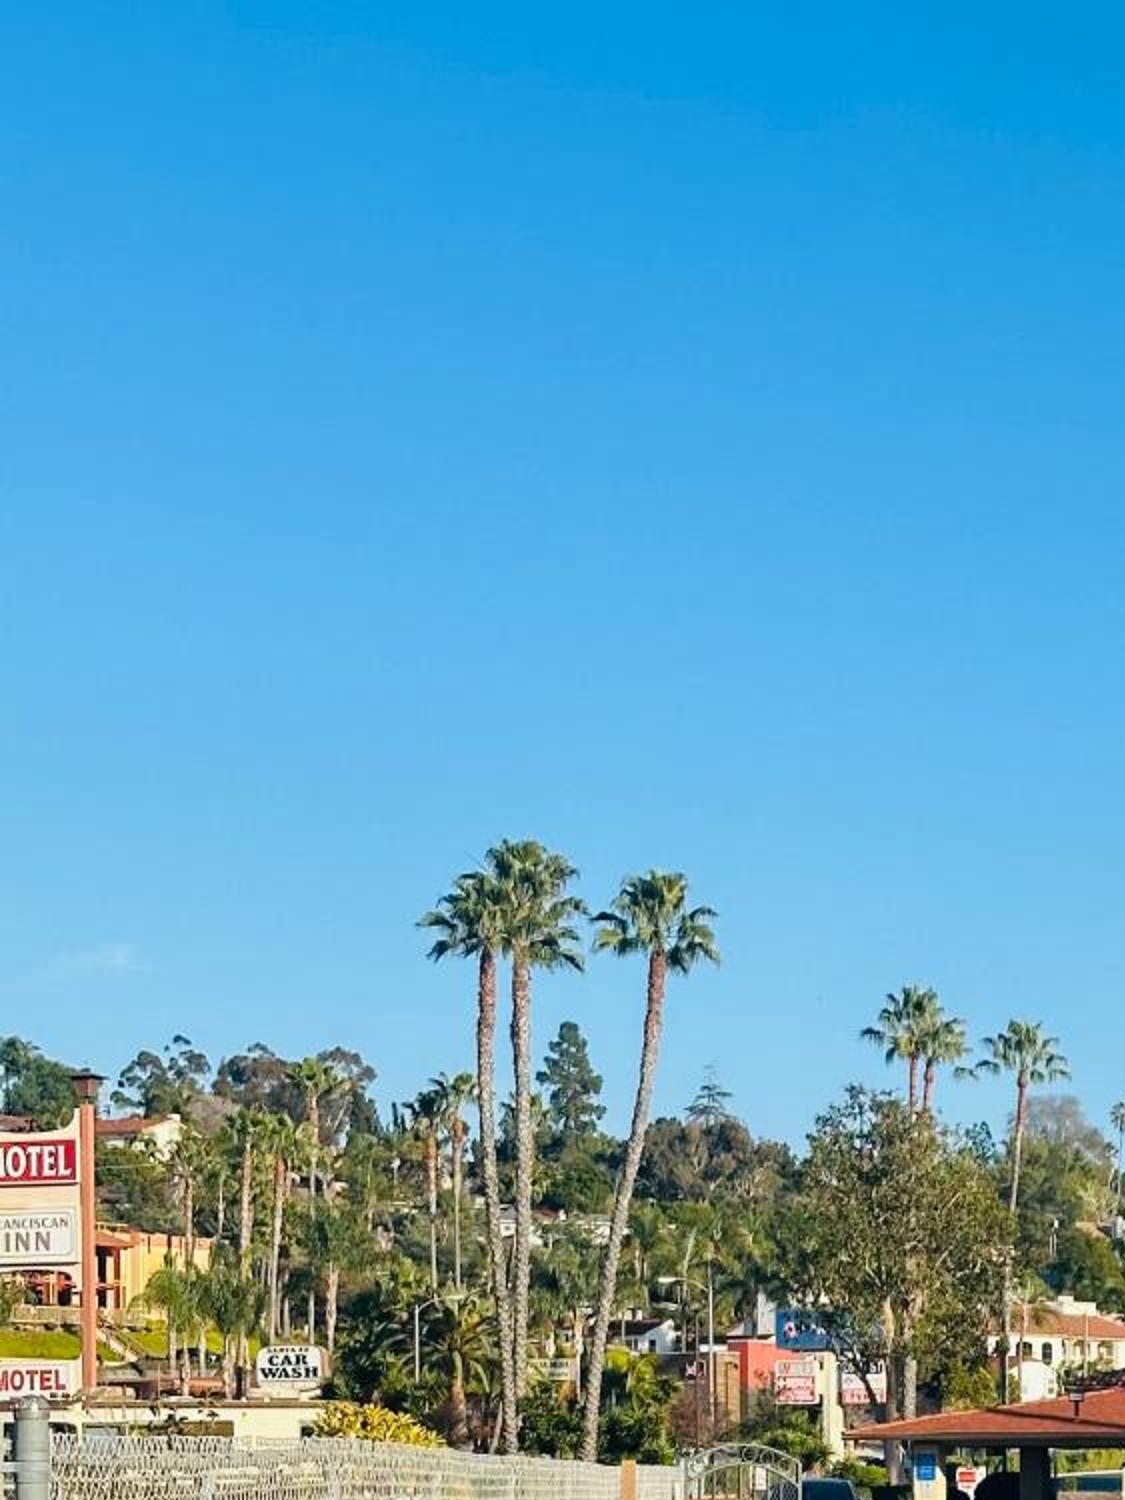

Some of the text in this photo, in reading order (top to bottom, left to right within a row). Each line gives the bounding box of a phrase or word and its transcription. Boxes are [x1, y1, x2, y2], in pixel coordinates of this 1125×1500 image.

[0, 1145, 72, 1177] OTEL
[0, 1217, 68, 1229] ANCISCAN
[5, 1231, 50, 1252] INN
[268, 1354, 307, 1366] CAR
[260, 1367, 318, 1378] WASH
